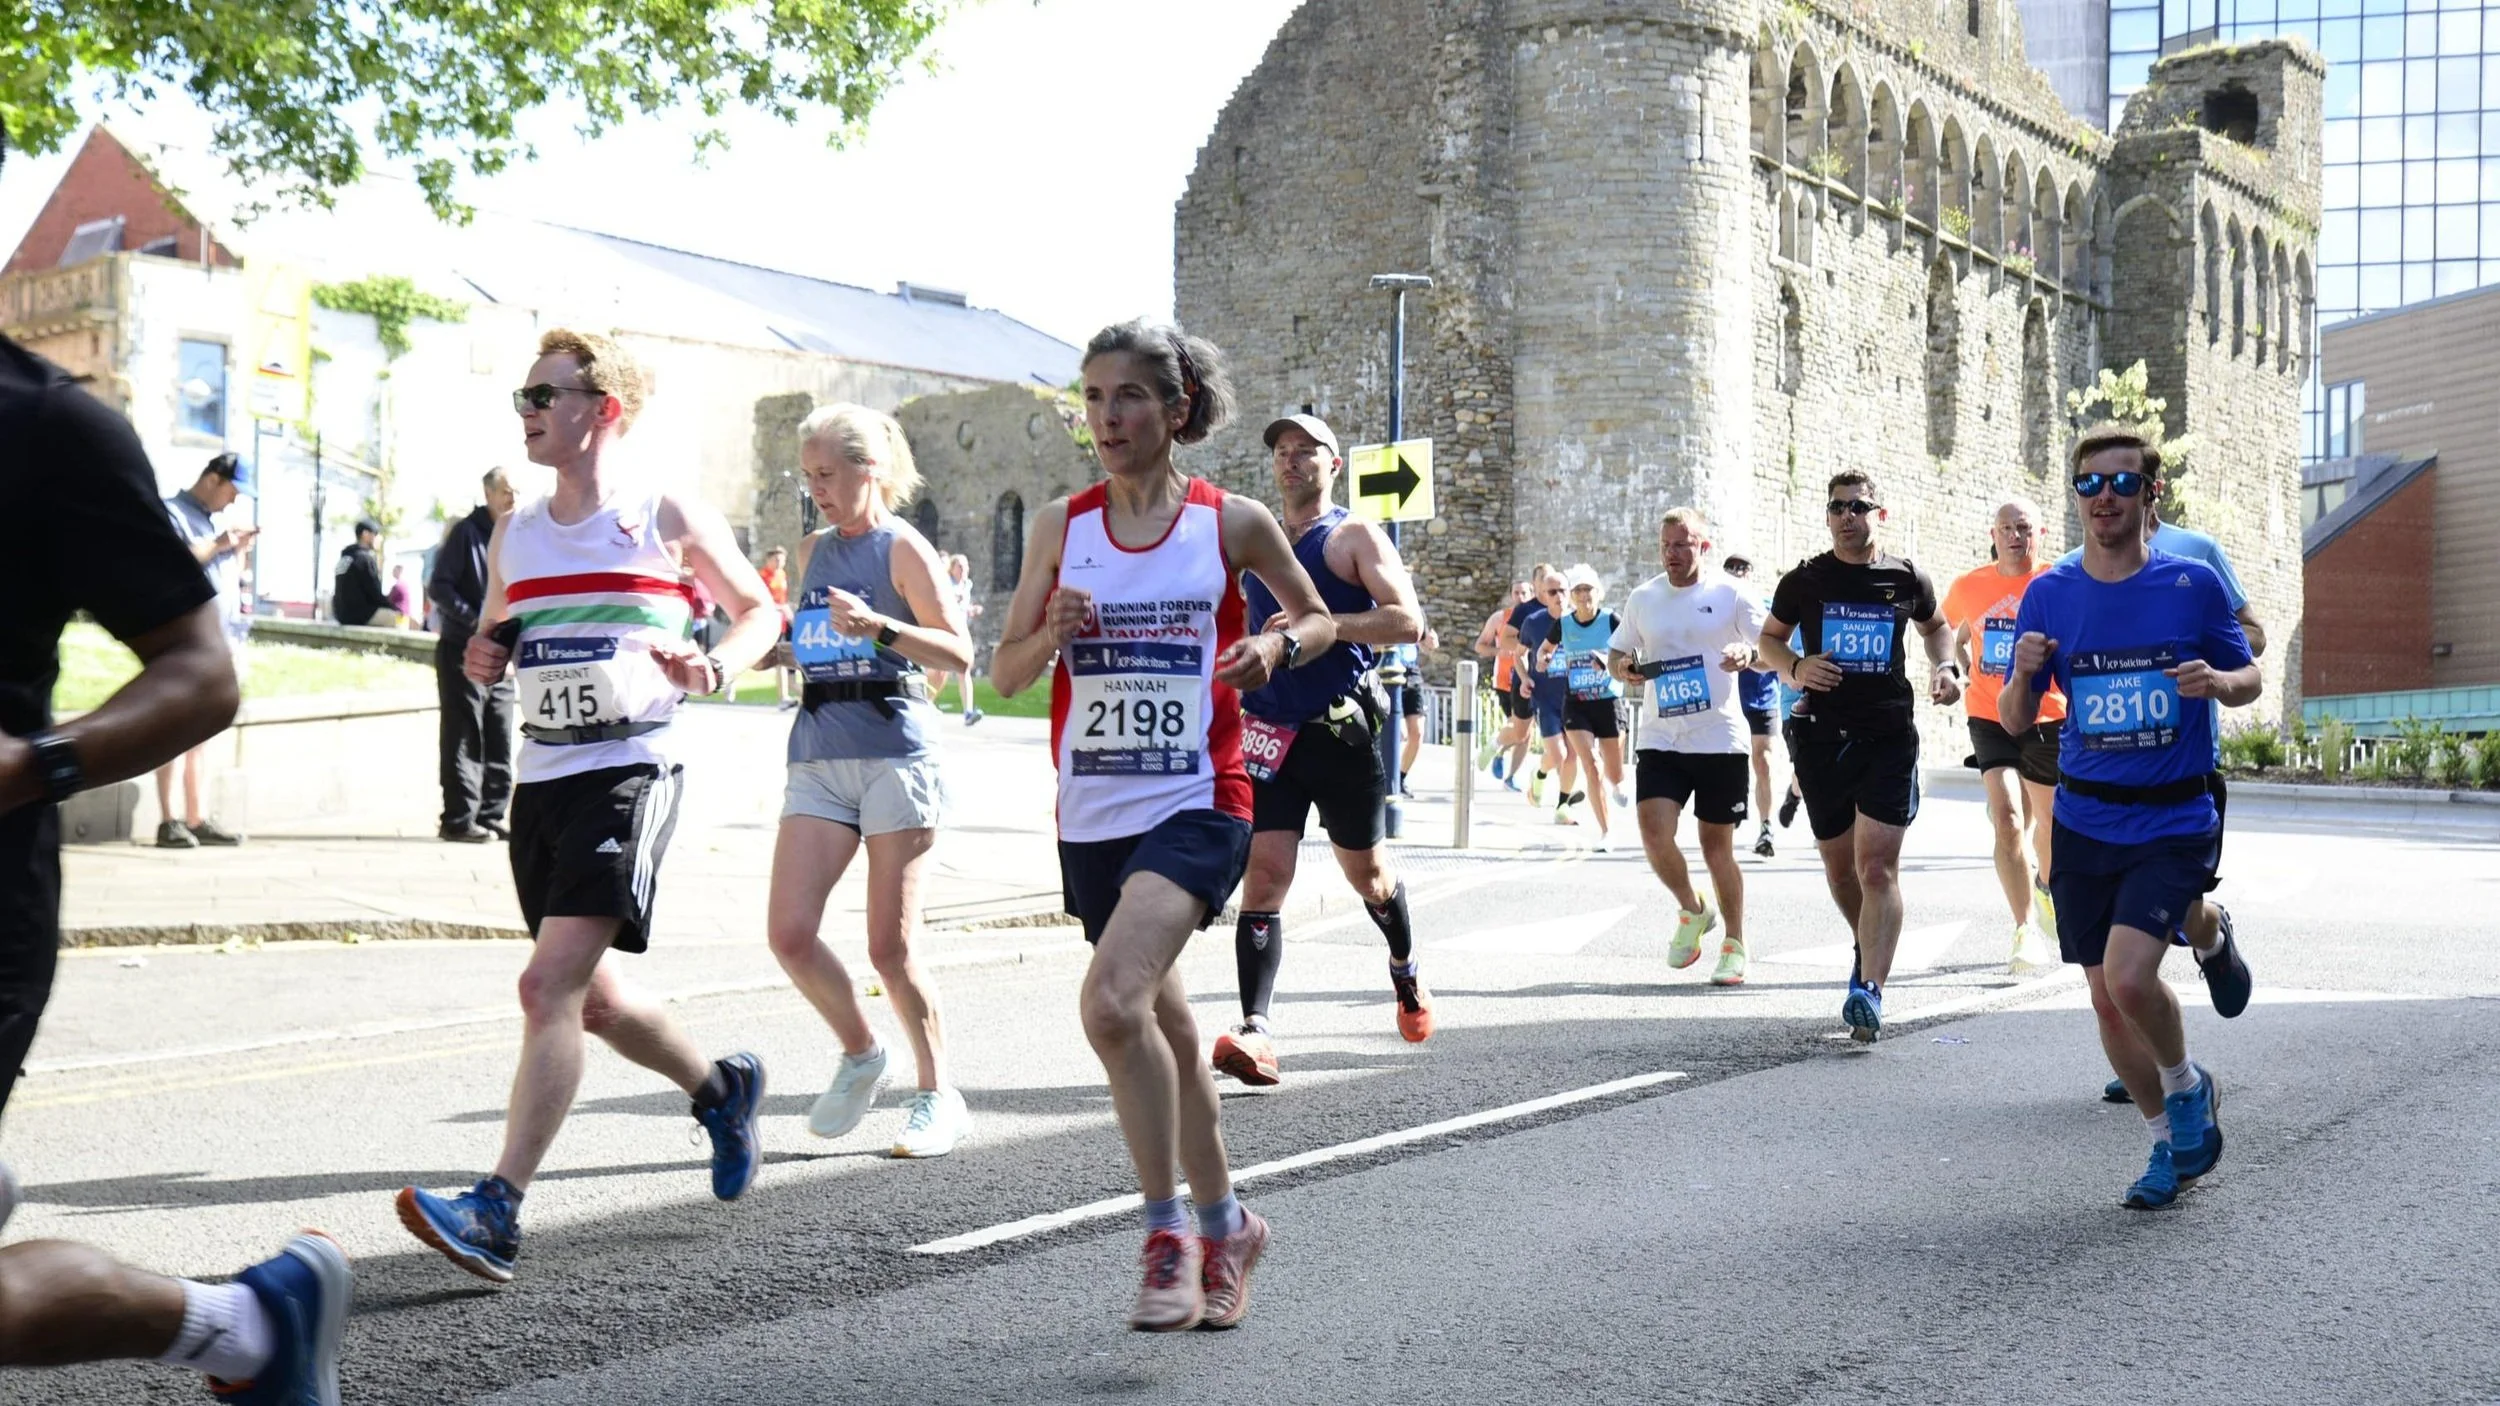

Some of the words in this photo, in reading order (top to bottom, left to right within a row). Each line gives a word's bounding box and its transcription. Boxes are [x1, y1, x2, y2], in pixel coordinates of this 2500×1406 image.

[1102, 601, 1157, 614] RUNNING
[1160, 600, 1212, 612] FOREVER
[1103, 614, 1157, 627] RUNNING
[1160, 613, 1190, 624] CLUB
[1105, 627, 1199, 638] TAUNTON
[1842, 623, 1876, 632] SANJAY
[1831, 632, 1886, 655] 1310
[1995, 642, 2013, 659] 68
[2107, 659, 2118, 669] JCP
[2119, 658, 2153, 669] Solicitors
[539, 667, 590, 682] GERAINT
[1667, 672, 1686, 682] PAUL
[1104, 680, 1167, 693] HANNAH
[2108, 676, 2142, 689] JAKE
[1660, 680, 1703, 702] 4163
[539, 684, 598, 720] 415
[2085, 689, 2169, 725] 2810
[1085, 699, 1185, 737] 2198
[1251, 720, 1277, 734] JAMES
